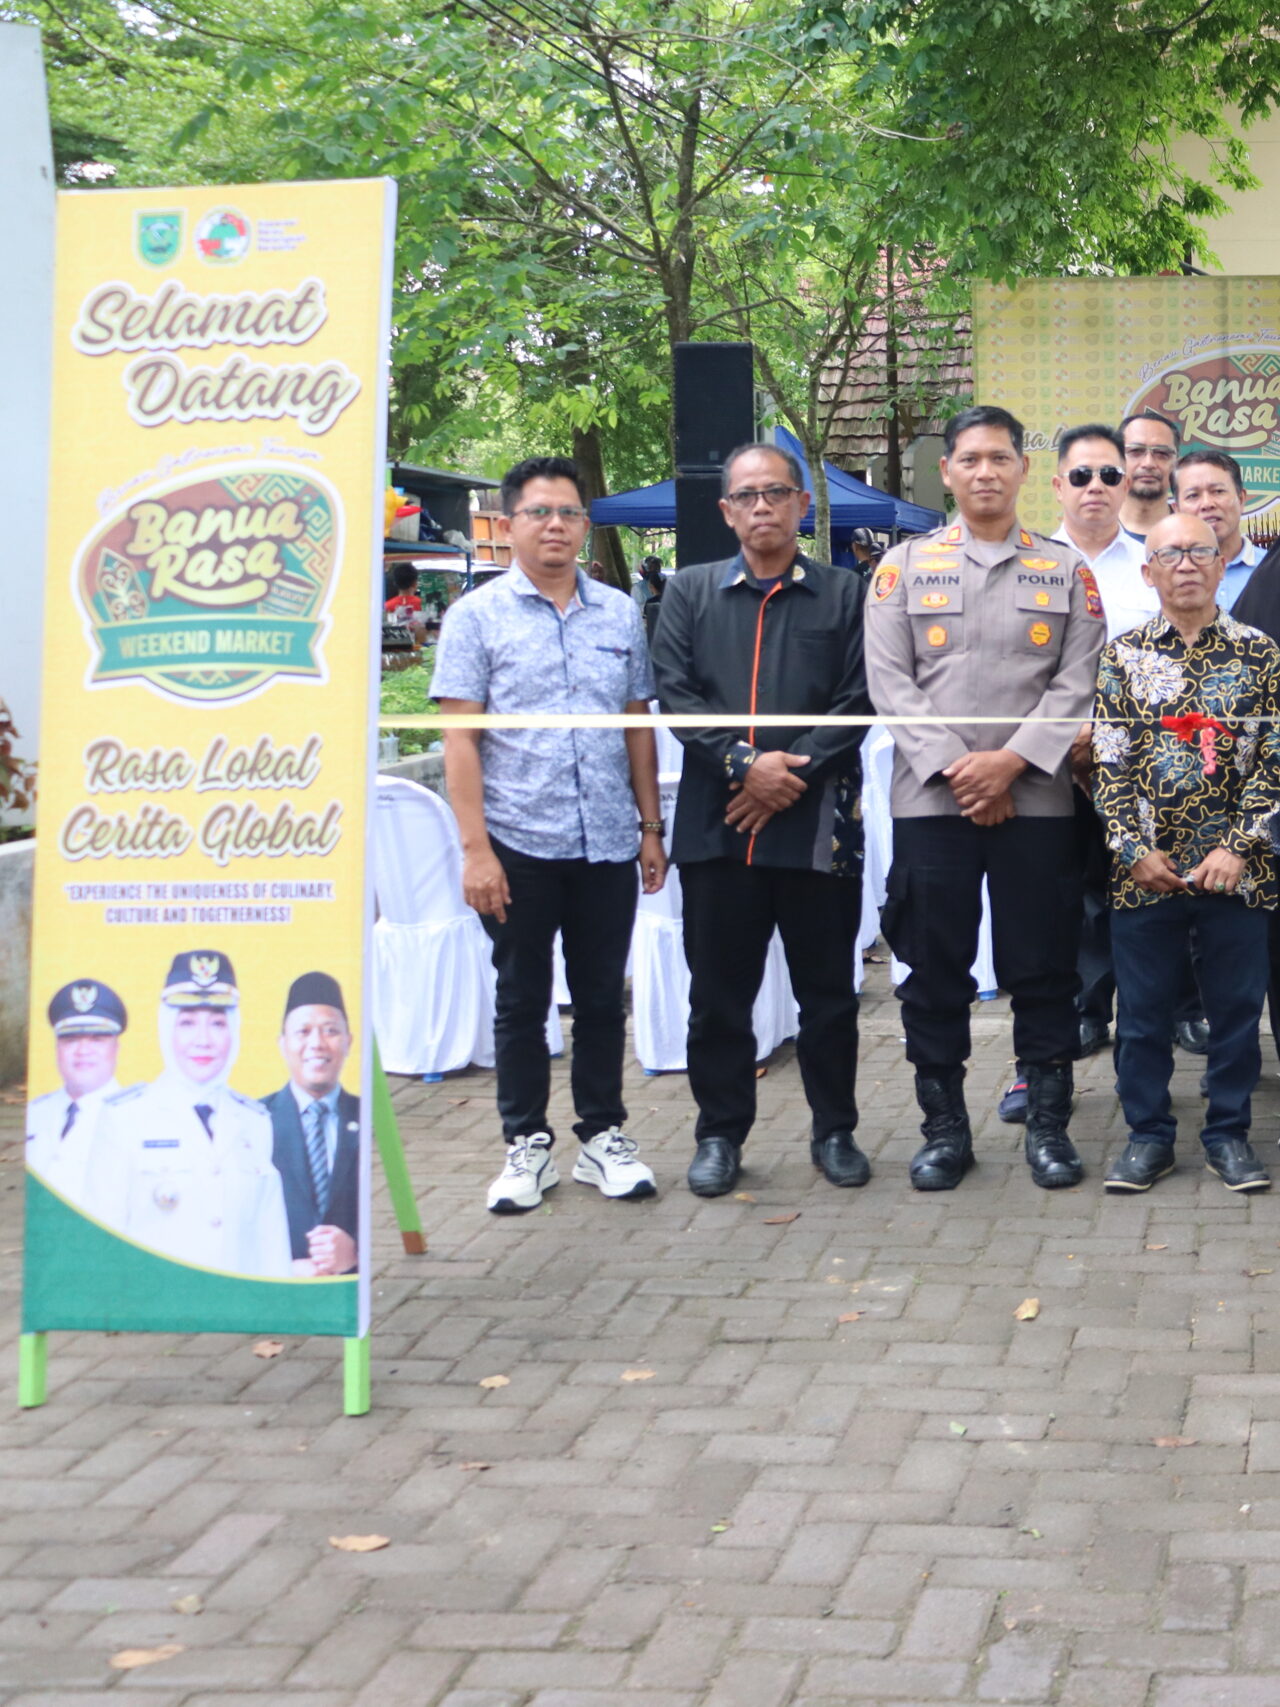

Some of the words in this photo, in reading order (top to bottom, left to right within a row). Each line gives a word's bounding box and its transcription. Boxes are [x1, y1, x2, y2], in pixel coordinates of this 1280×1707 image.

[79, 284, 325, 346] Selamat
[130, 360, 352, 426] Datang
[1178, 403, 1278, 448] Rasa
[125, 500, 303, 556] Banua
[146, 540, 283, 605] Rasa
[913, 575, 960, 586] AMIN
[1017, 574, 1065, 587] POLRI
[118, 631, 211, 659] WEEKEND
[214, 629, 296, 656] MARKET
[86, 740, 193, 789] Rasa
[197, 736, 321, 789] Lokal
[63, 804, 191, 856] Cerita
[200, 802, 342, 861] Global
[106, 907, 160, 923] CULTURE
[163, 906, 188, 922] AND
[147, 884, 168, 900] THE
[172, 883, 250, 900] UNIQUENESS
[252, 882, 268, 899] OF
